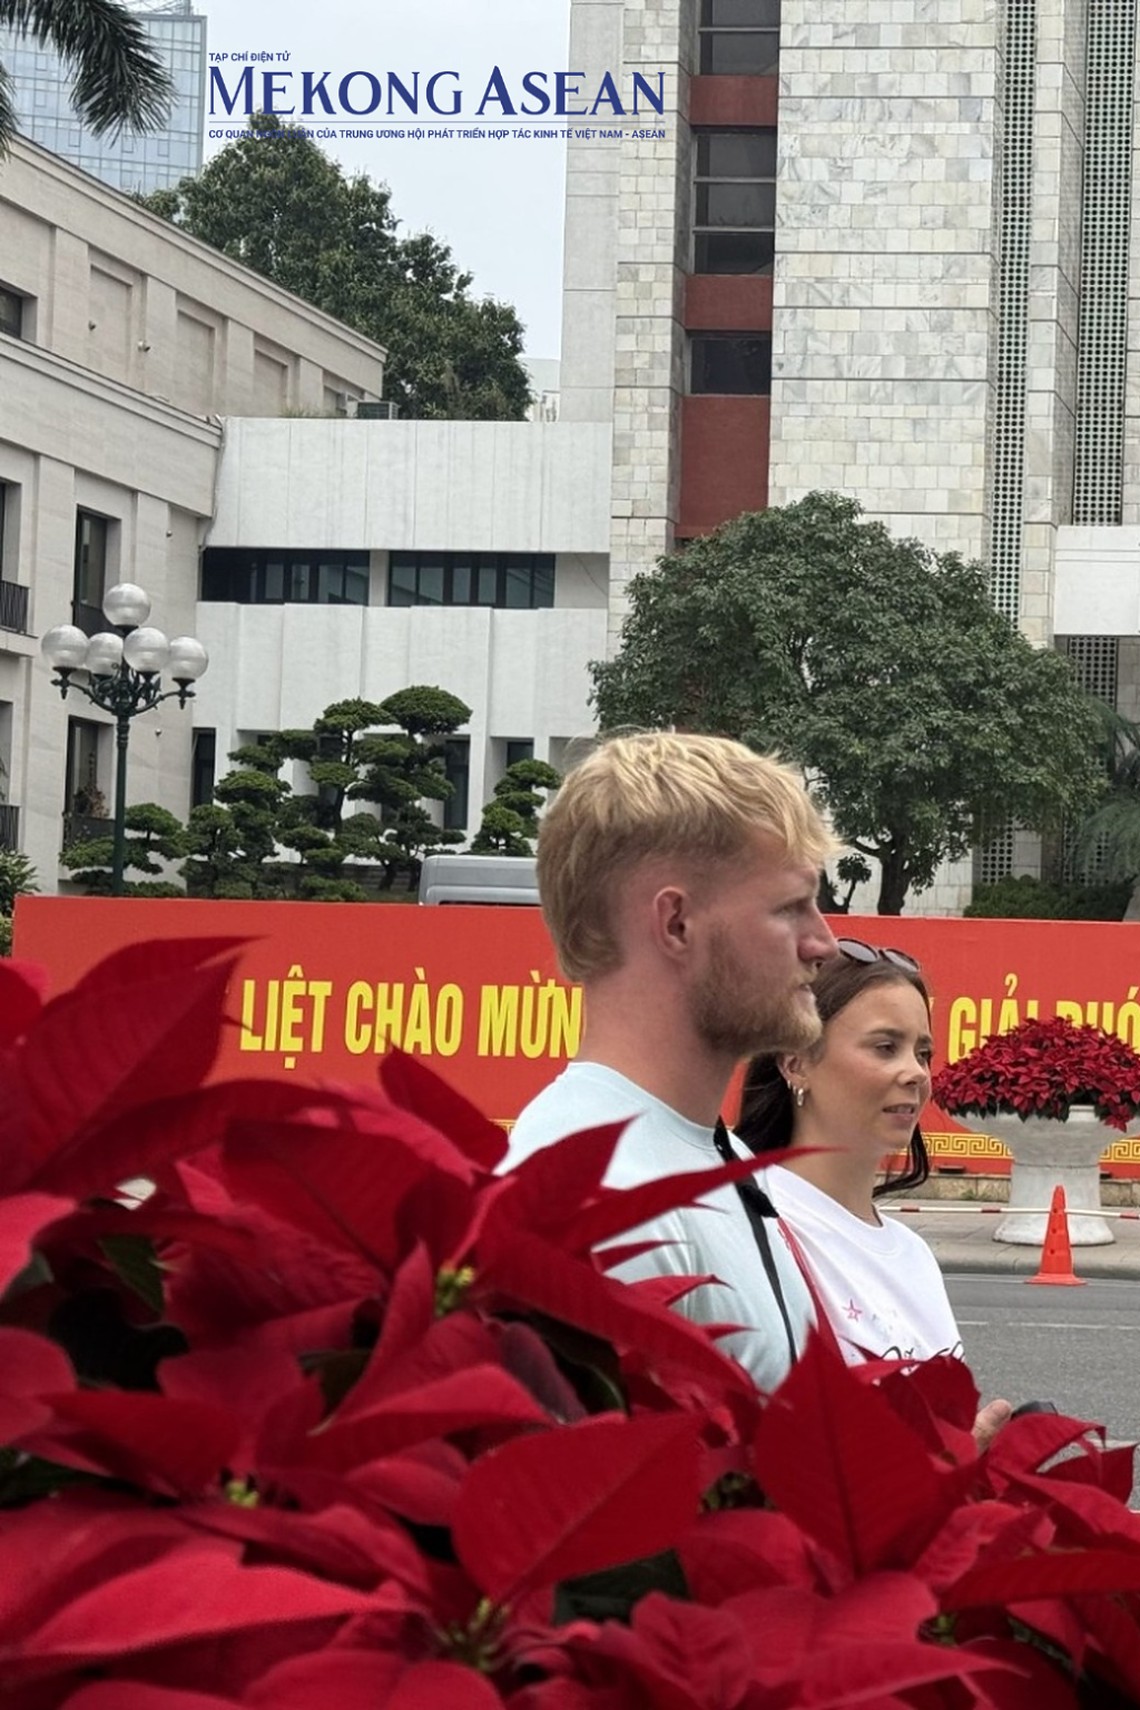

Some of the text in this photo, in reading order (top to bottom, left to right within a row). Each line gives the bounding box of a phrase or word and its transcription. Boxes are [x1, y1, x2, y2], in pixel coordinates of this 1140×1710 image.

[240, 964, 332, 1069] LIỆT
[345, 967, 464, 1057] CHÀO
[477, 970, 583, 1059] MỪN
